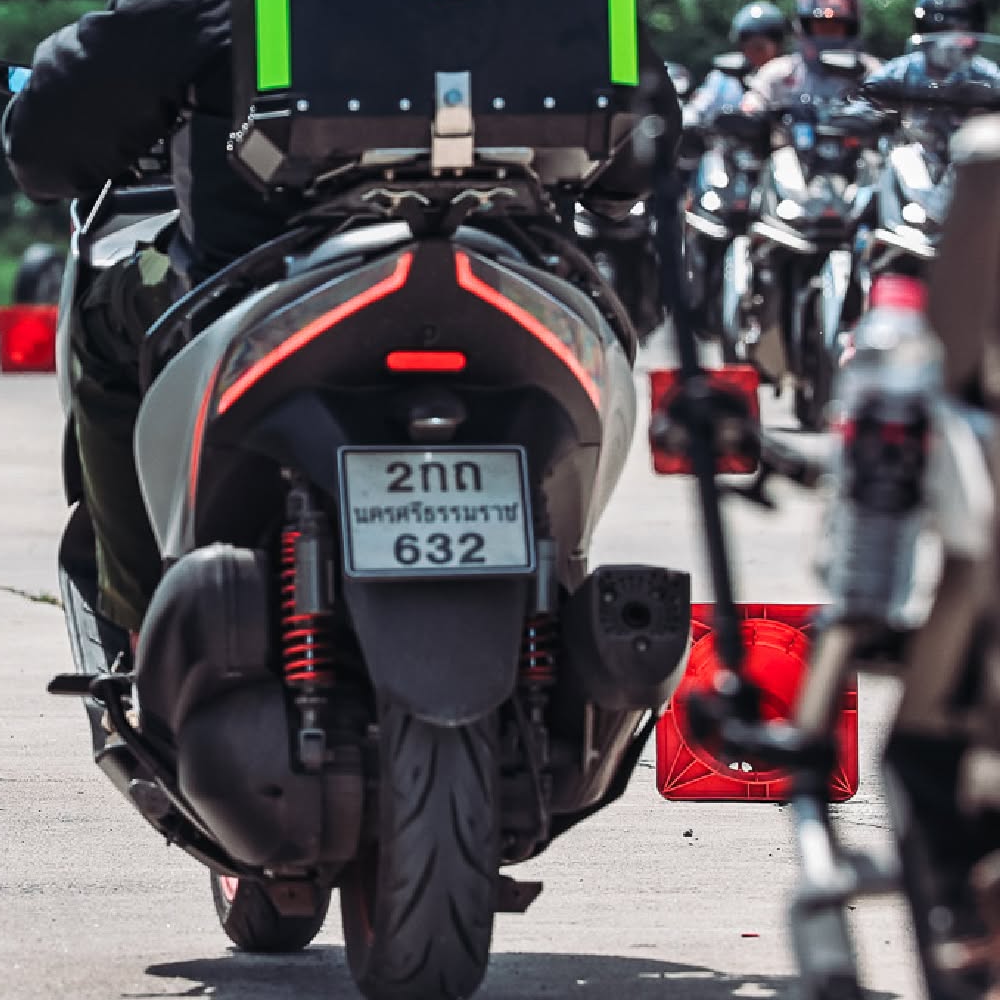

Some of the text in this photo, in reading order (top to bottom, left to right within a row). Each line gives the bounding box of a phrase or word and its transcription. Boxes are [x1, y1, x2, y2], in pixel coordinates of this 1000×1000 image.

[354, 501, 519, 524] นครศรีธรรมราช
[393, 533, 486, 565] 632
